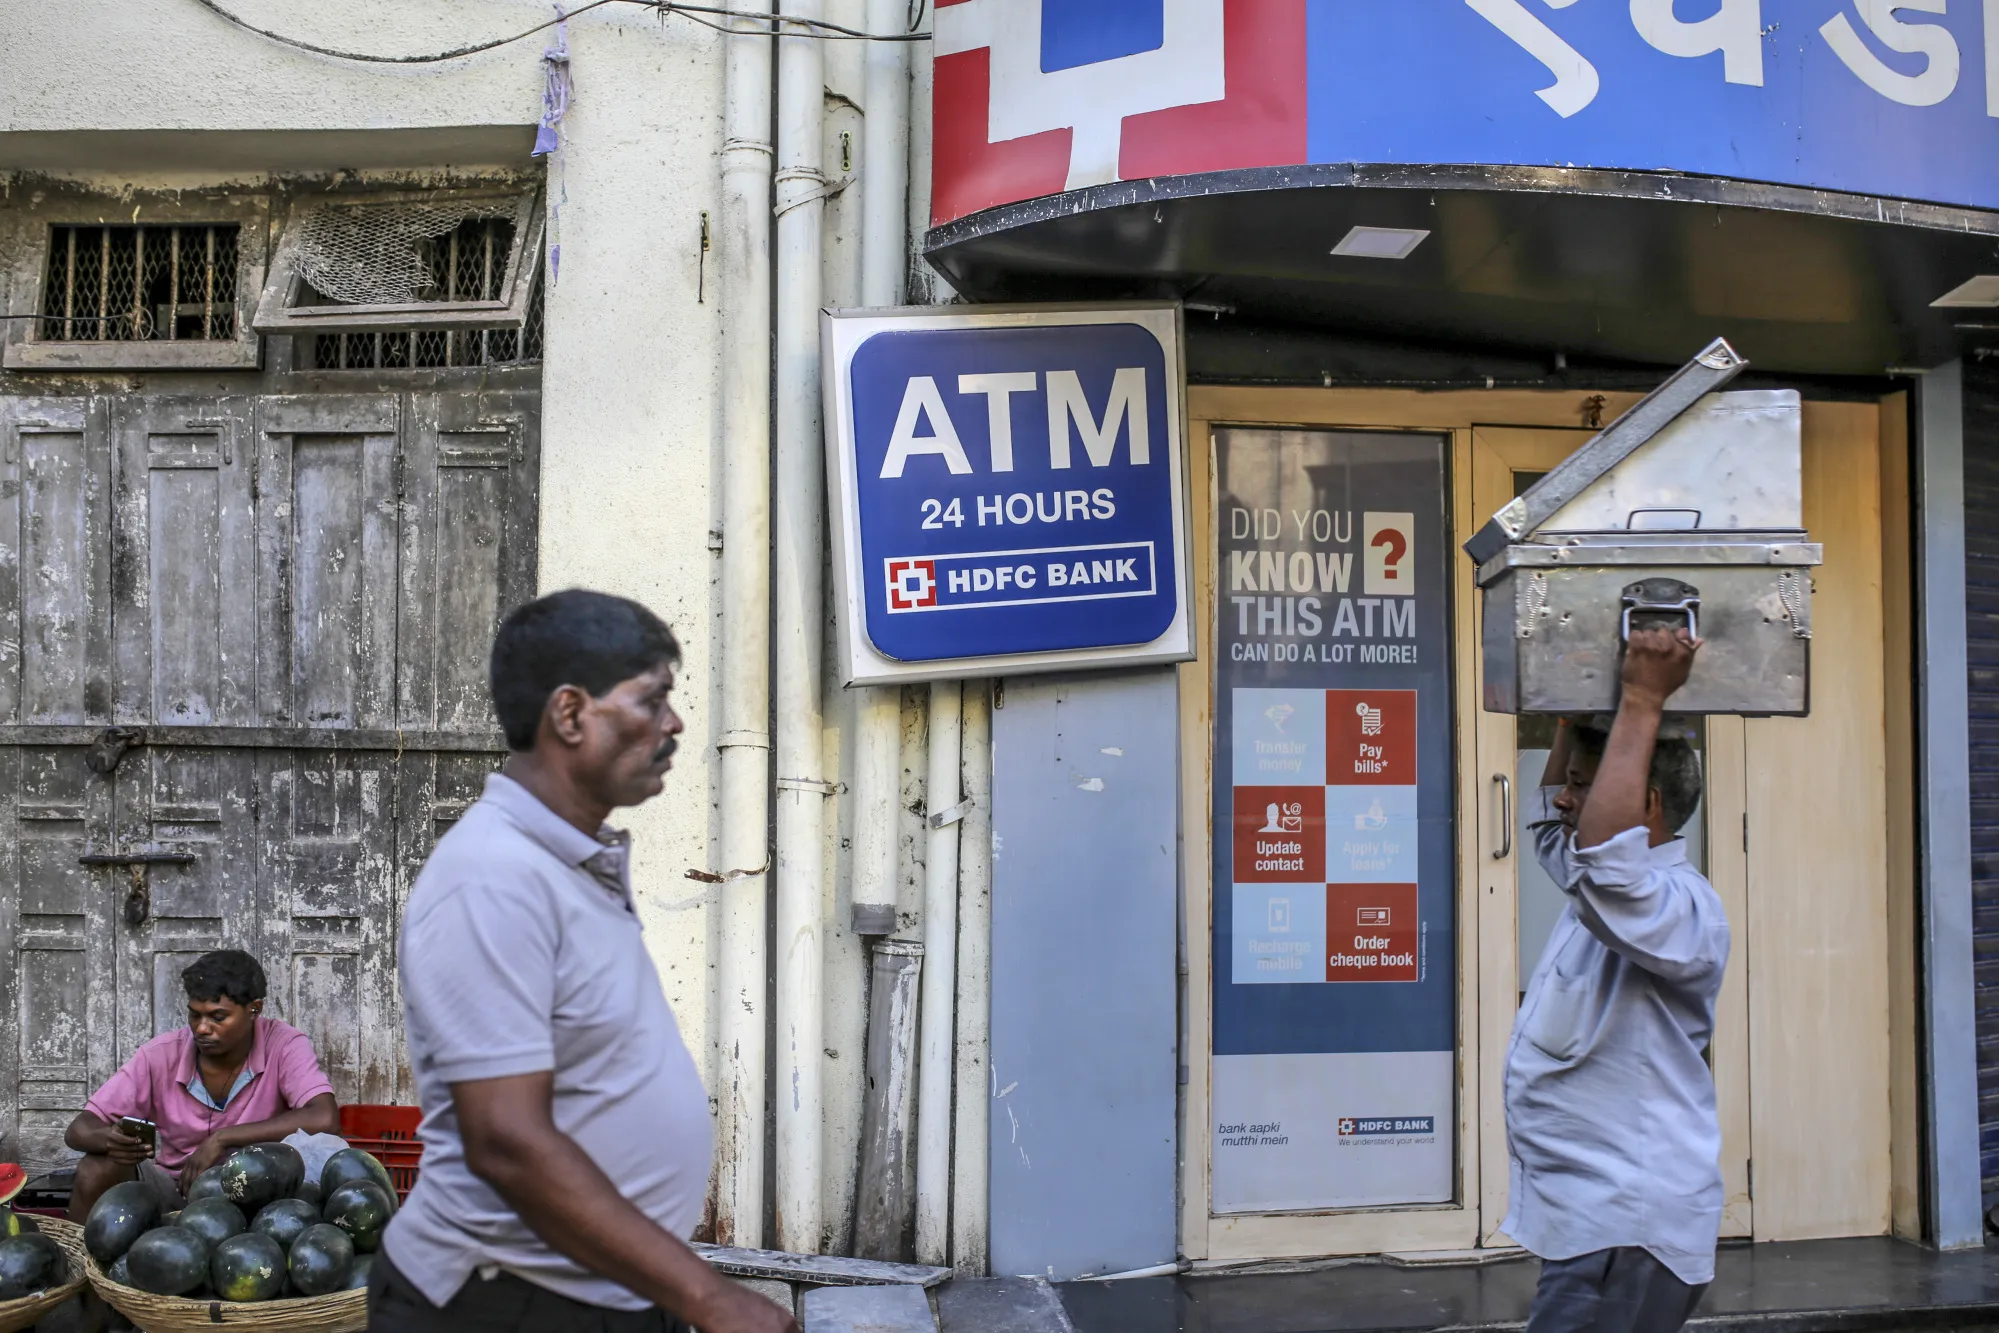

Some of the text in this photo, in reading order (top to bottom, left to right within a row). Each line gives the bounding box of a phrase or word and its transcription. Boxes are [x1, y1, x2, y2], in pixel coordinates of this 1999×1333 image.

[879, 367, 1150, 479] ATM
[920, 488, 1116, 530] 24 HOURS
[1232, 508, 1352, 543] DID YOU
[948, 558, 1138, 594] HDFC BANK
[1231, 550, 1353, 593] KNOW
[1231, 596, 1416, 638] THIS ATM
[1231, 642, 1417, 664] CAN DO A LOT MORE!
[1253, 739, 1308, 755] Transfer
[1359, 743, 1383, 761] Pay
[1258, 758, 1303, 773] money
[1256, 840, 1302, 858] Update
[1342, 840, 1380, 857] Apply
[1255, 857, 1304, 871] contact
[1248, 938, 1312, 956] Recharge
[1354, 935, 1390, 950] Order
[1256, 956, 1303, 970] mobile
[1330, 951, 1414, 968] cheque book
[1218, 1121, 1281, 1135] bank aapki
[1359, 1120, 1429, 1131] HDFC BANK
[1221, 1134, 1289, 1146] mutthi mein
[1338, 1138, 1351, 1146] We
[1352, 1137, 1394, 1146] understand
[1396, 1138, 1412, 1147] your
